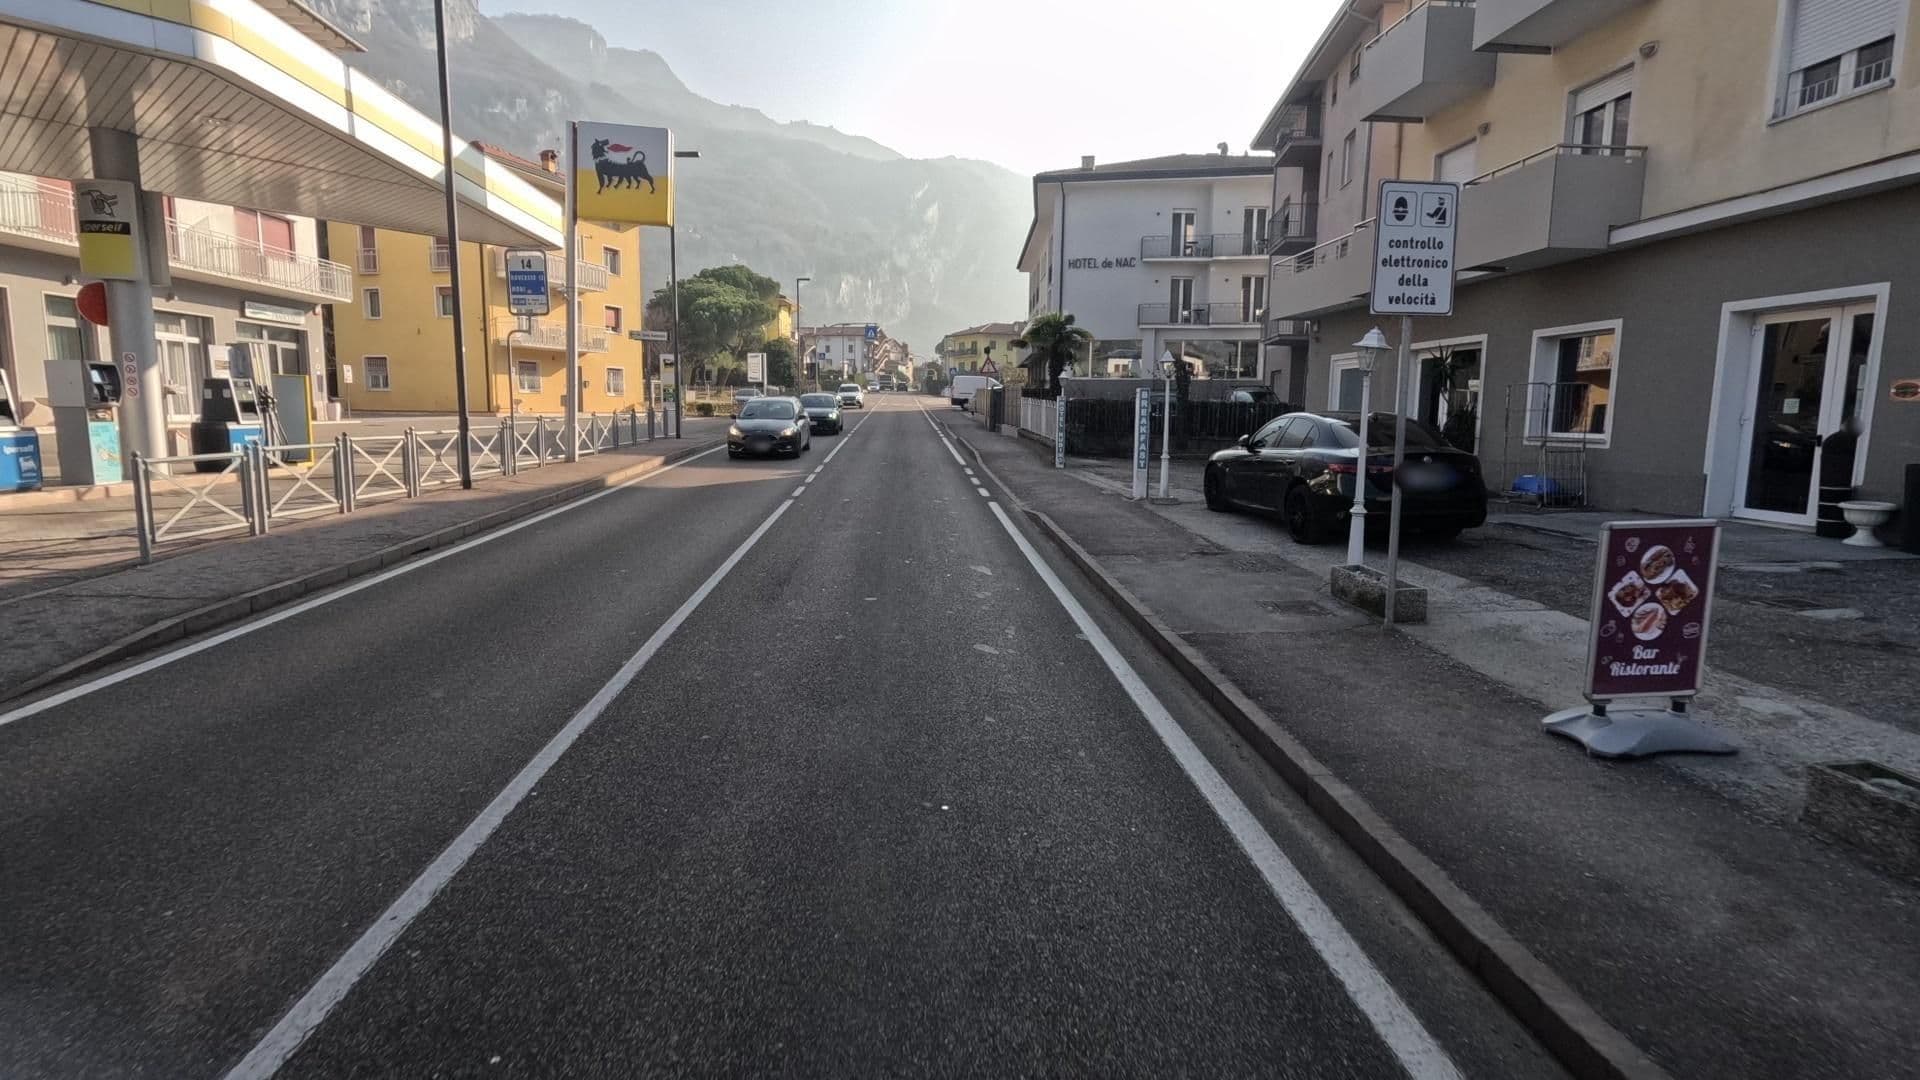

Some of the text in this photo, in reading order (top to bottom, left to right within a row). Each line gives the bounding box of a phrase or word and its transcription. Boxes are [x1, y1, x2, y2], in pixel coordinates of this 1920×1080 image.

[1388, 236, 1444, 250] controllo
[521, 259, 532, 269] 14
[1068, 256, 1137, 269] HOTEL de NAC
[1381, 254, 1448, 269] elettronico
[1398, 273, 1428, 287] della
[1388, 292, 1436, 306] velocità
[1138, 390, 1148, 469] BREAKFAST
[1632, 644, 1659, 659] Bar
[1609, 661, 1681, 676] Ristorante
